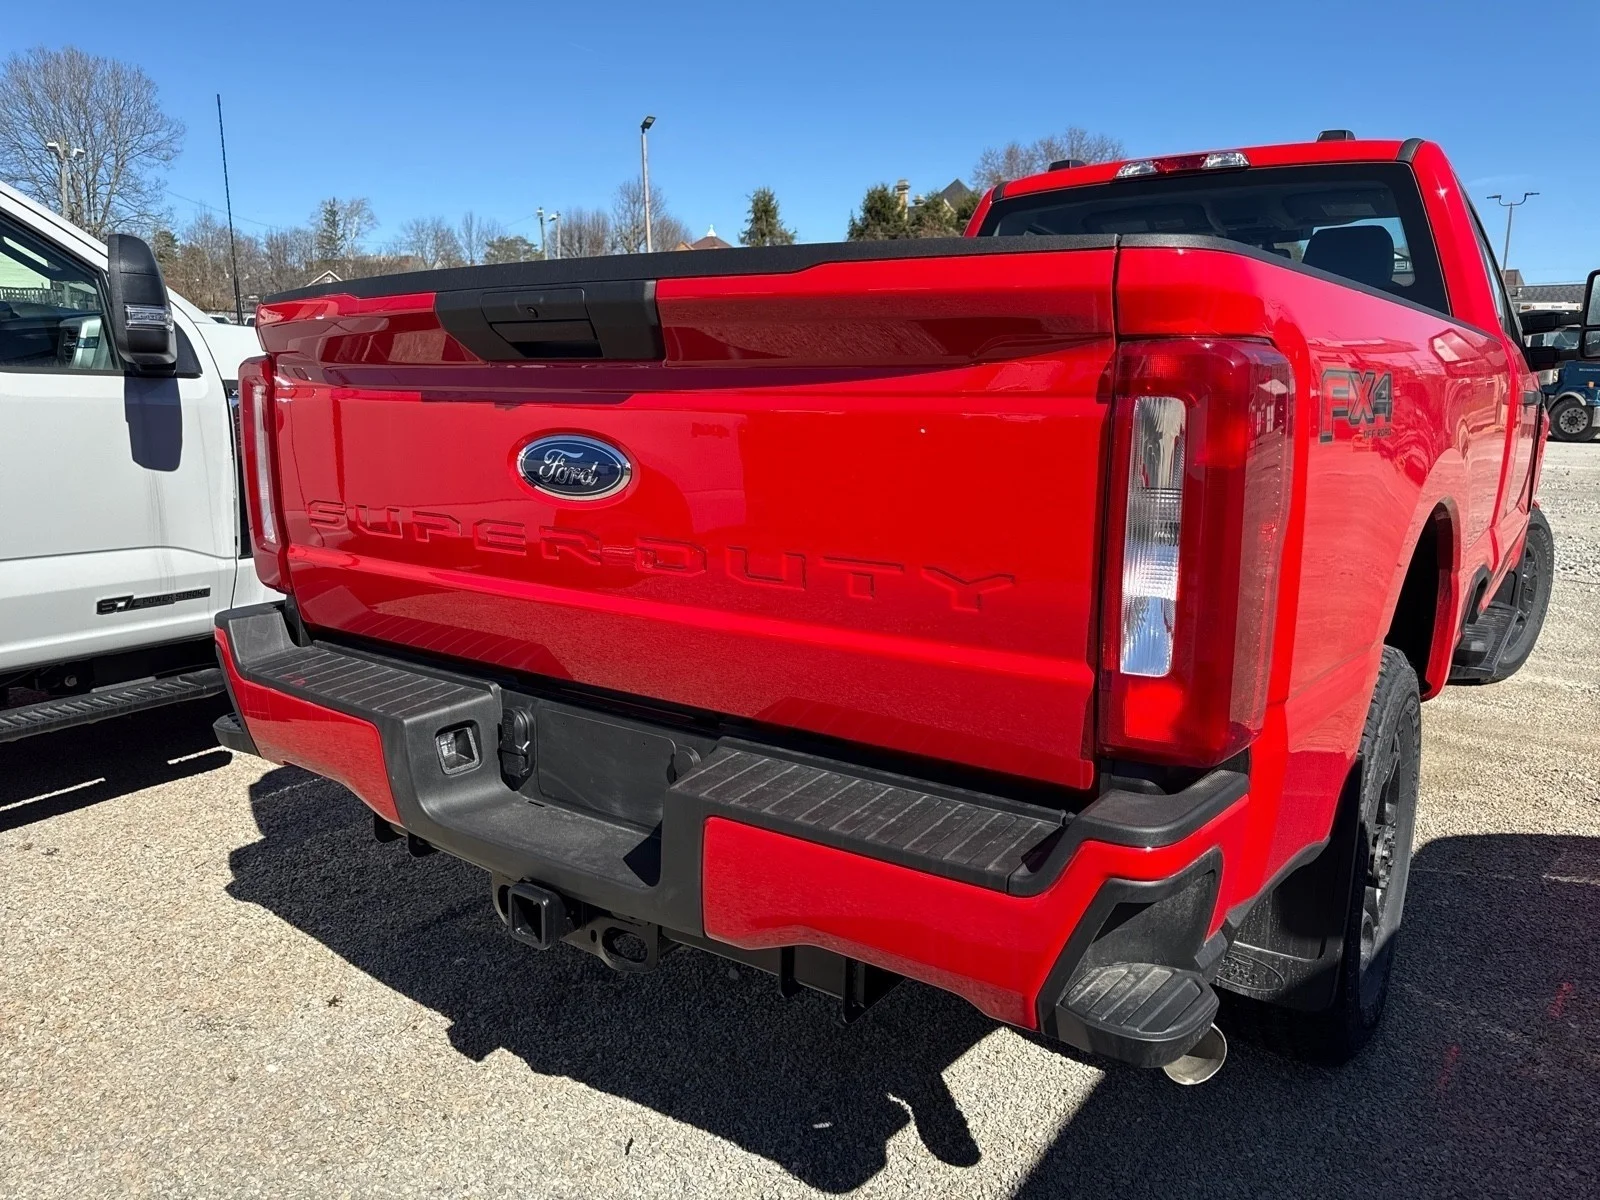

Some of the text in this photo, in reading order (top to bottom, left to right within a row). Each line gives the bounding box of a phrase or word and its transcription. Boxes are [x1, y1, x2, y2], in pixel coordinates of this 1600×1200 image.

[1319, 369, 1393, 443] FX4
[1363, 430, 1376, 438] OFF
[539, 449, 599, 486] Ford
[307, 499, 1016, 613] SUPER DUTY
[142, 594, 174, 605] POWER
[175, 588, 210, 601] STROKE
